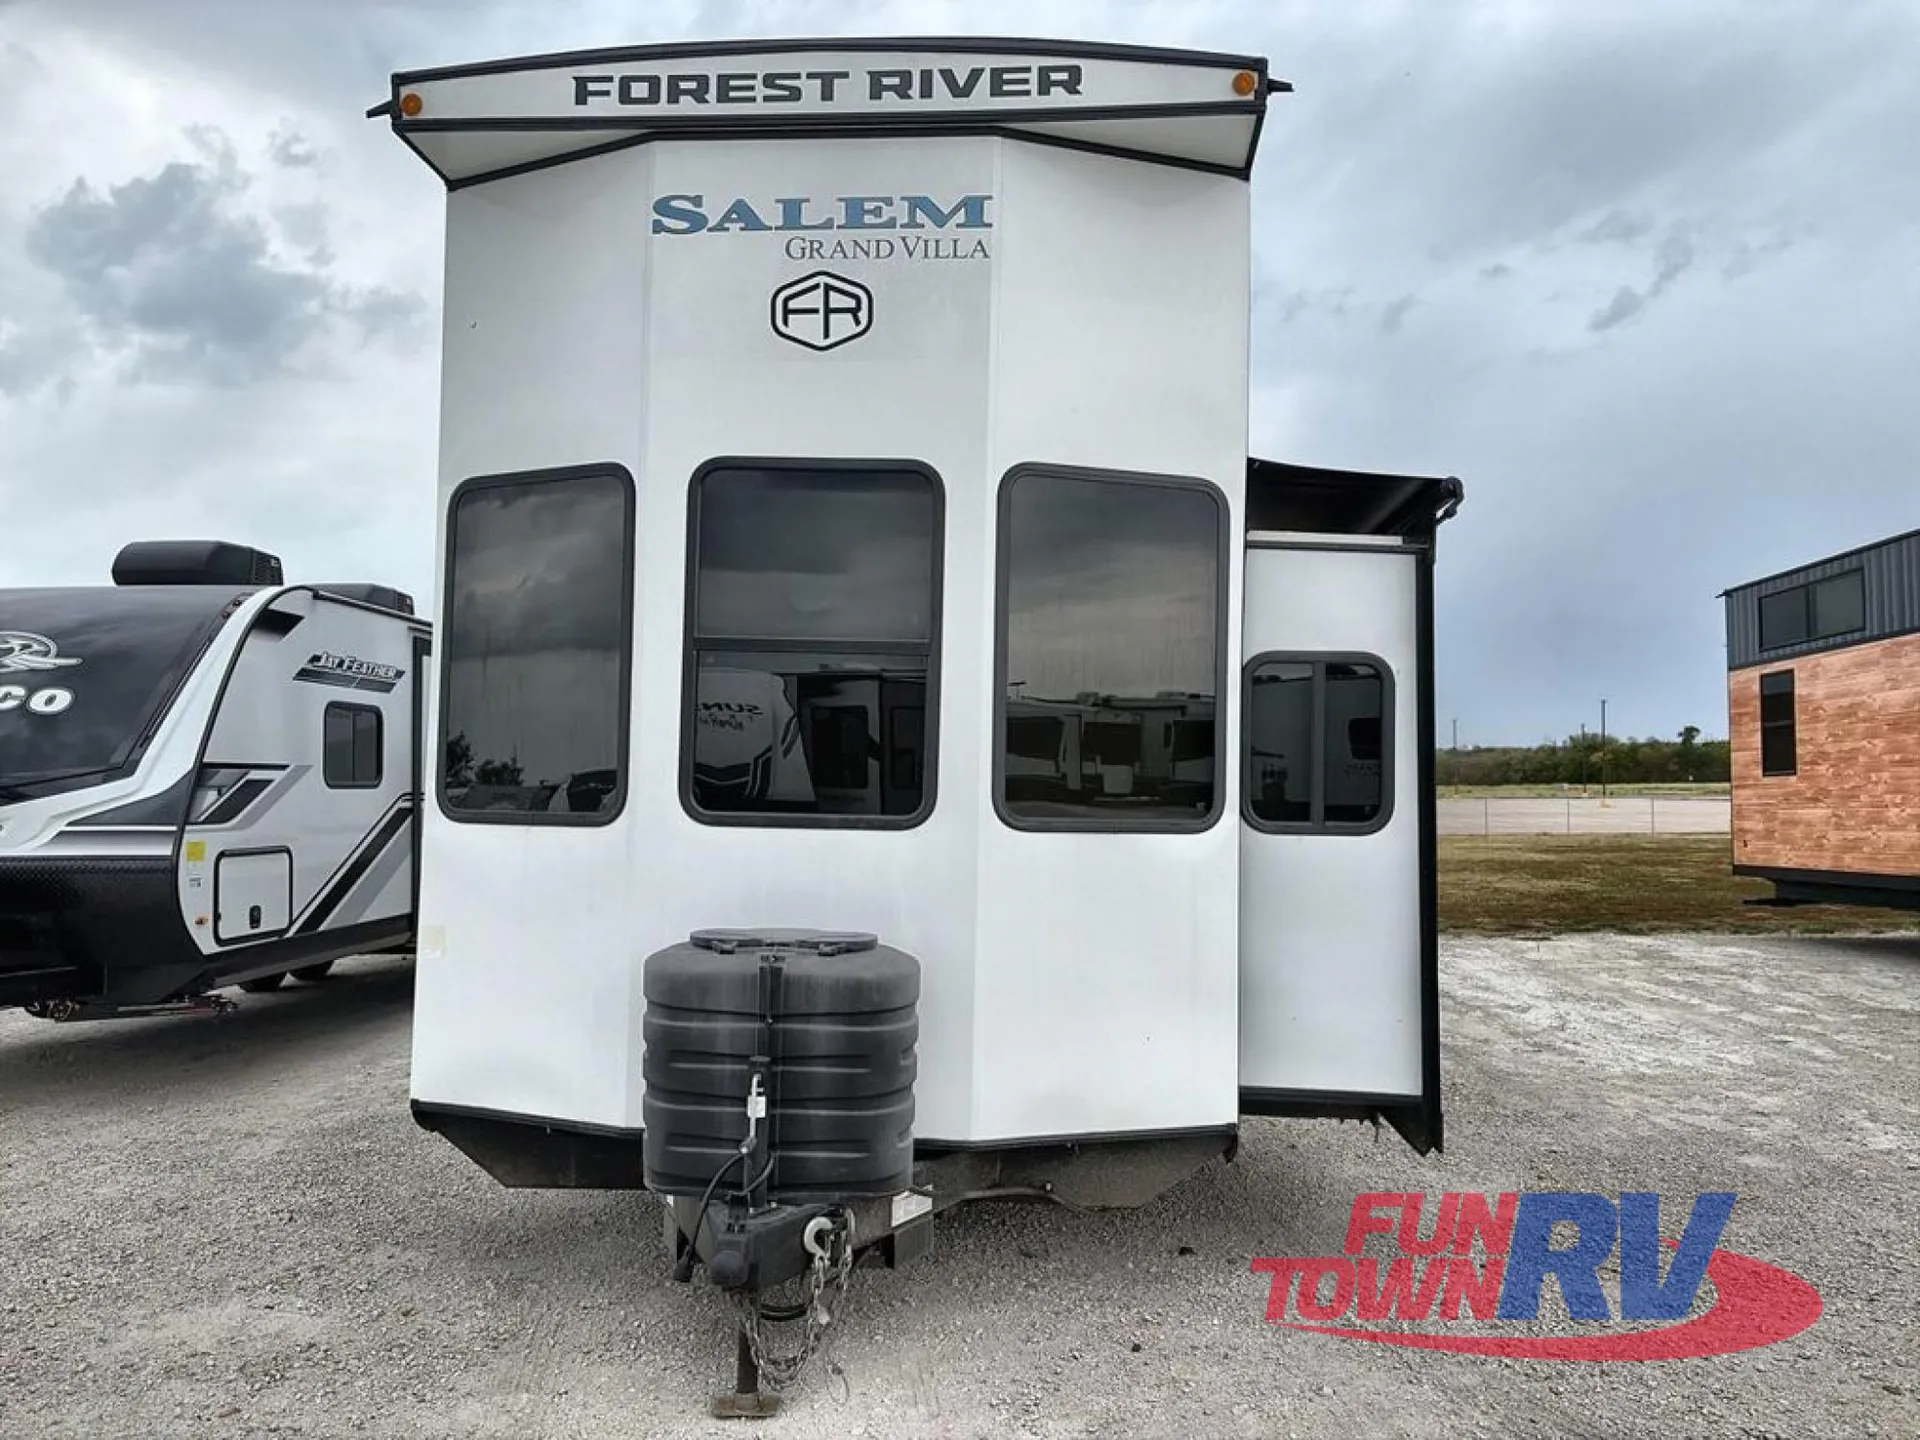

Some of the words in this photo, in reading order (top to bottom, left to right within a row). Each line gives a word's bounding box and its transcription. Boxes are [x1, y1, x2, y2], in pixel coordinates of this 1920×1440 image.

[573, 70, 850, 106] FOREST
[866, 65, 1084, 101] RIVER
[651, 194, 993, 235] SALEM
[785, 236, 895, 260] GRAND
[899, 235, 991, 260] VILLA
[780, 281, 864, 341] FR
